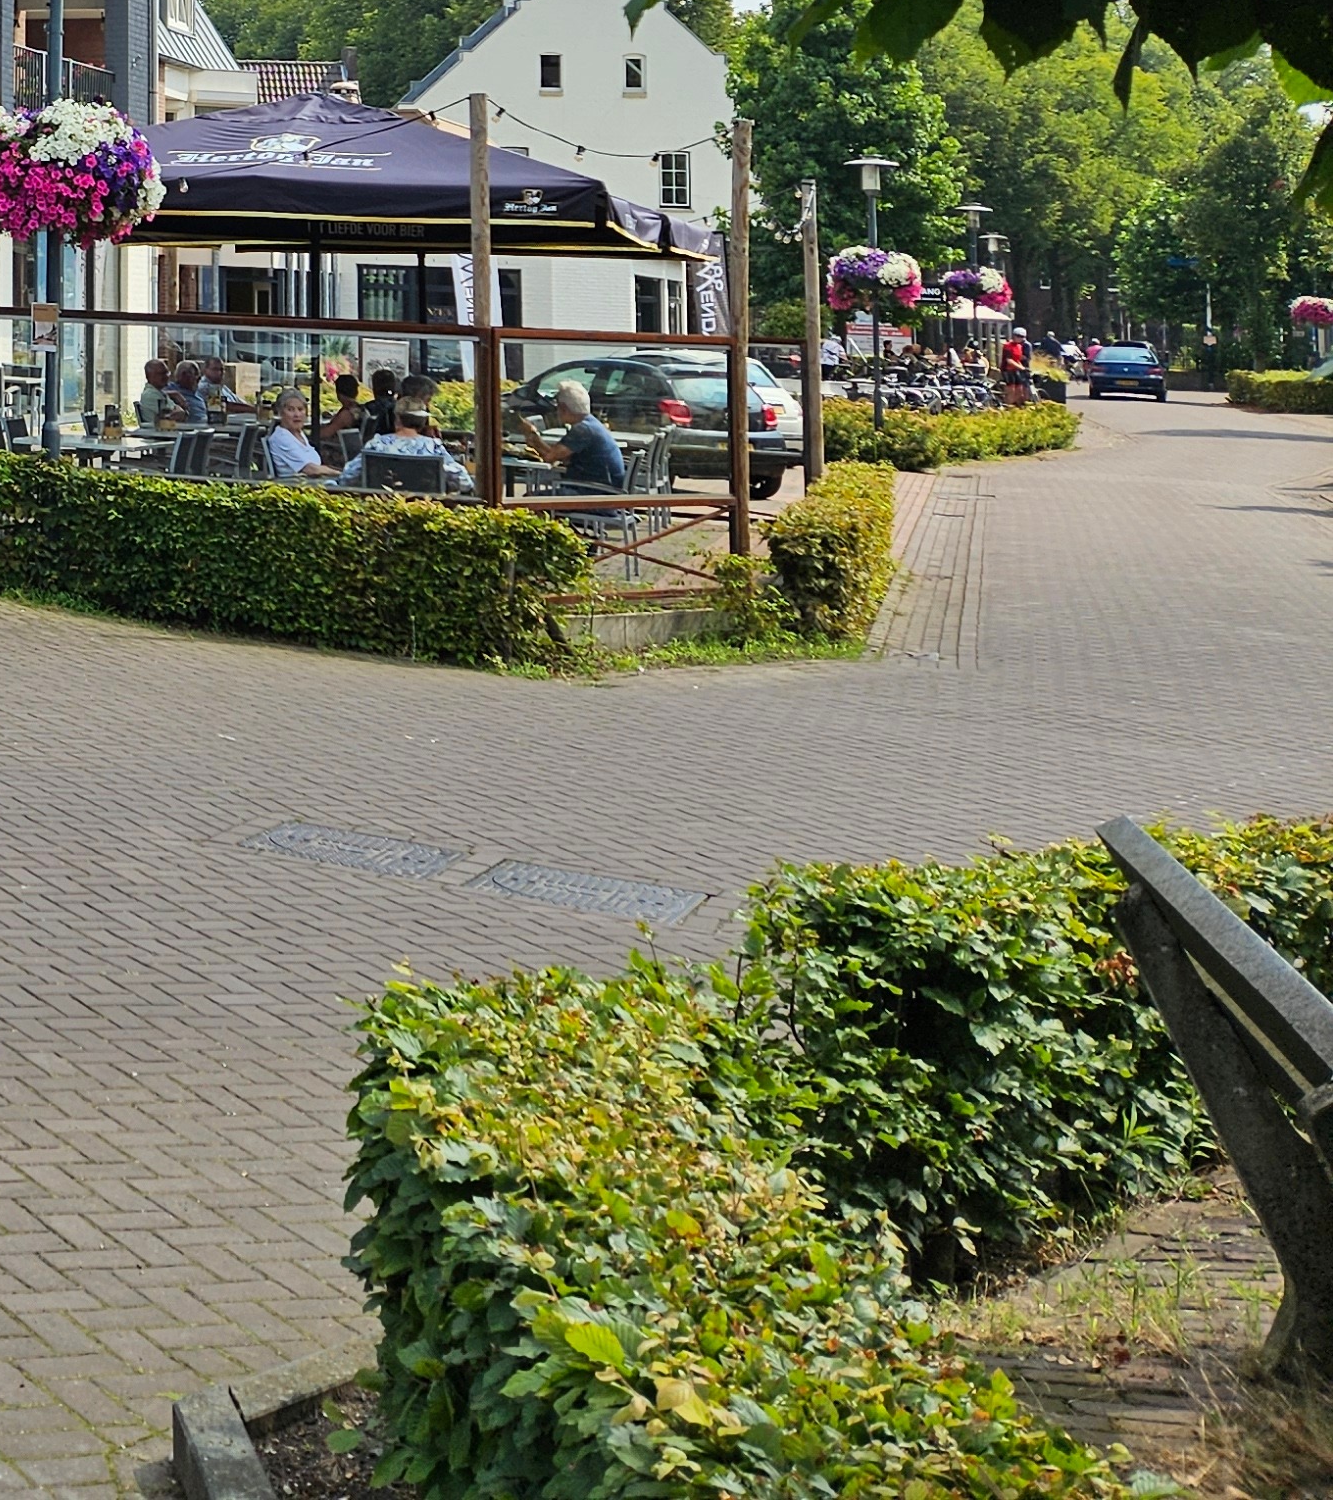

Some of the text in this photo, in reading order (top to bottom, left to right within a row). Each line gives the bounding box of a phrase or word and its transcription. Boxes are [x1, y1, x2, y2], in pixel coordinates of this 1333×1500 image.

[328, 222, 364, 235] LIEFDE
[366, 223, 396, 236] VOOR
[399, 225, 425, 237] BIER
